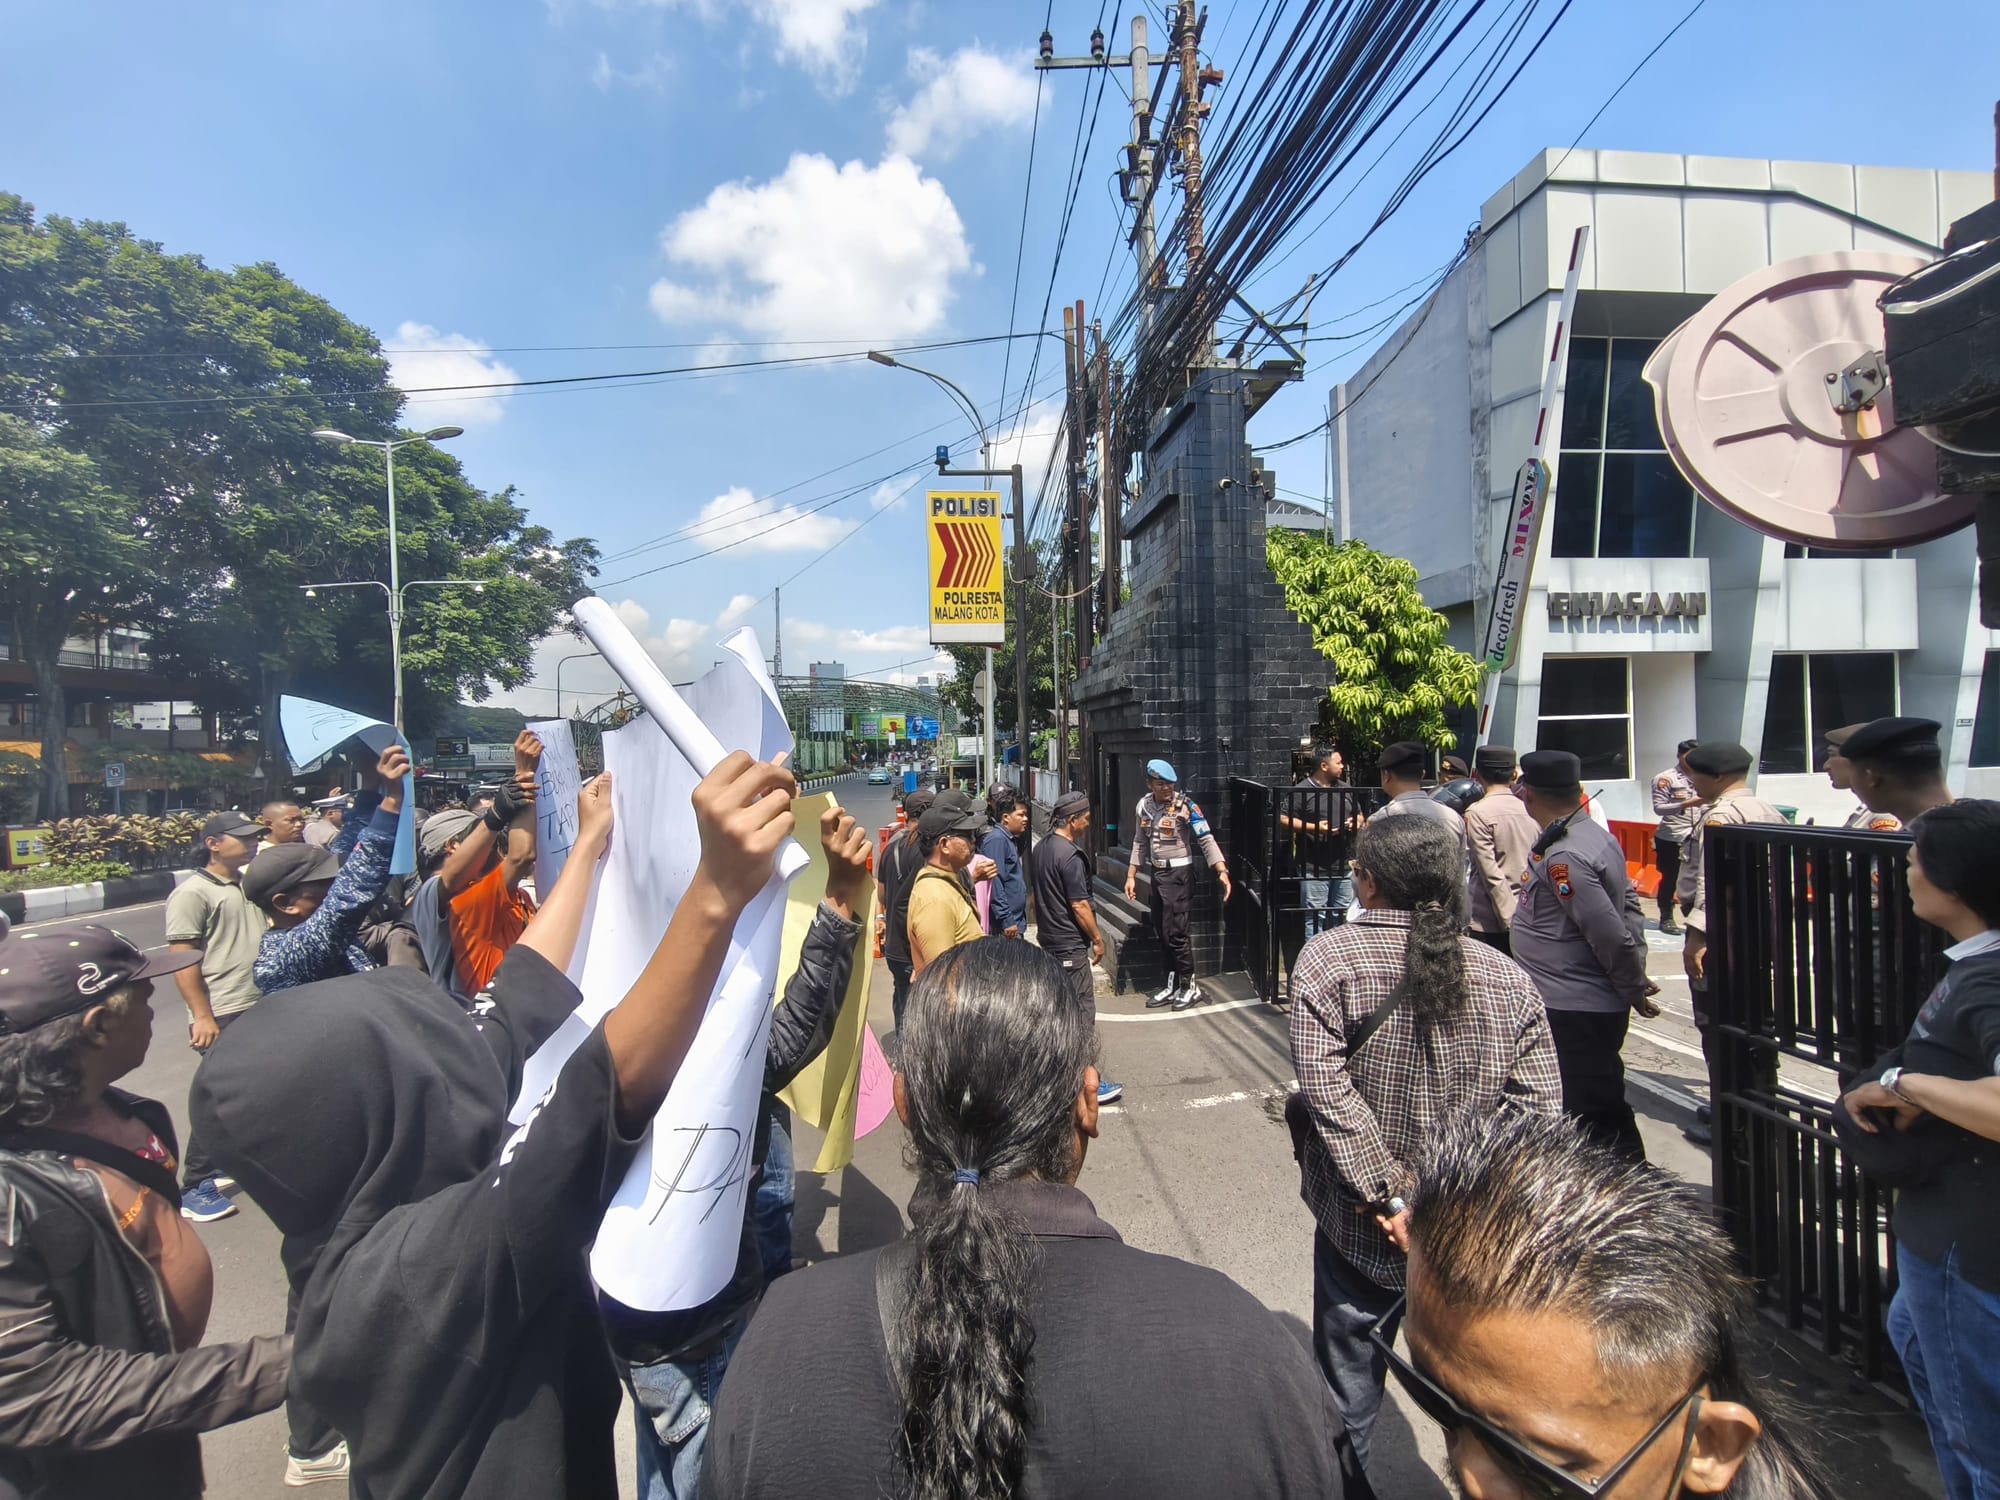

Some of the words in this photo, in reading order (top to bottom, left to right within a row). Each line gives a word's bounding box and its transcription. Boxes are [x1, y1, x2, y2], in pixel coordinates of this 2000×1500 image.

[931, 497, 997, 516] POLISI
[943, 591, 1003, 605] POLRESTA
[1546, 592, 1707, 616] ENJAGAAN
[934, 607, 973, 620] MALANG
[975, 607, 999, 620] KOTA
[1489, 580, 1519, 662] decofresh
